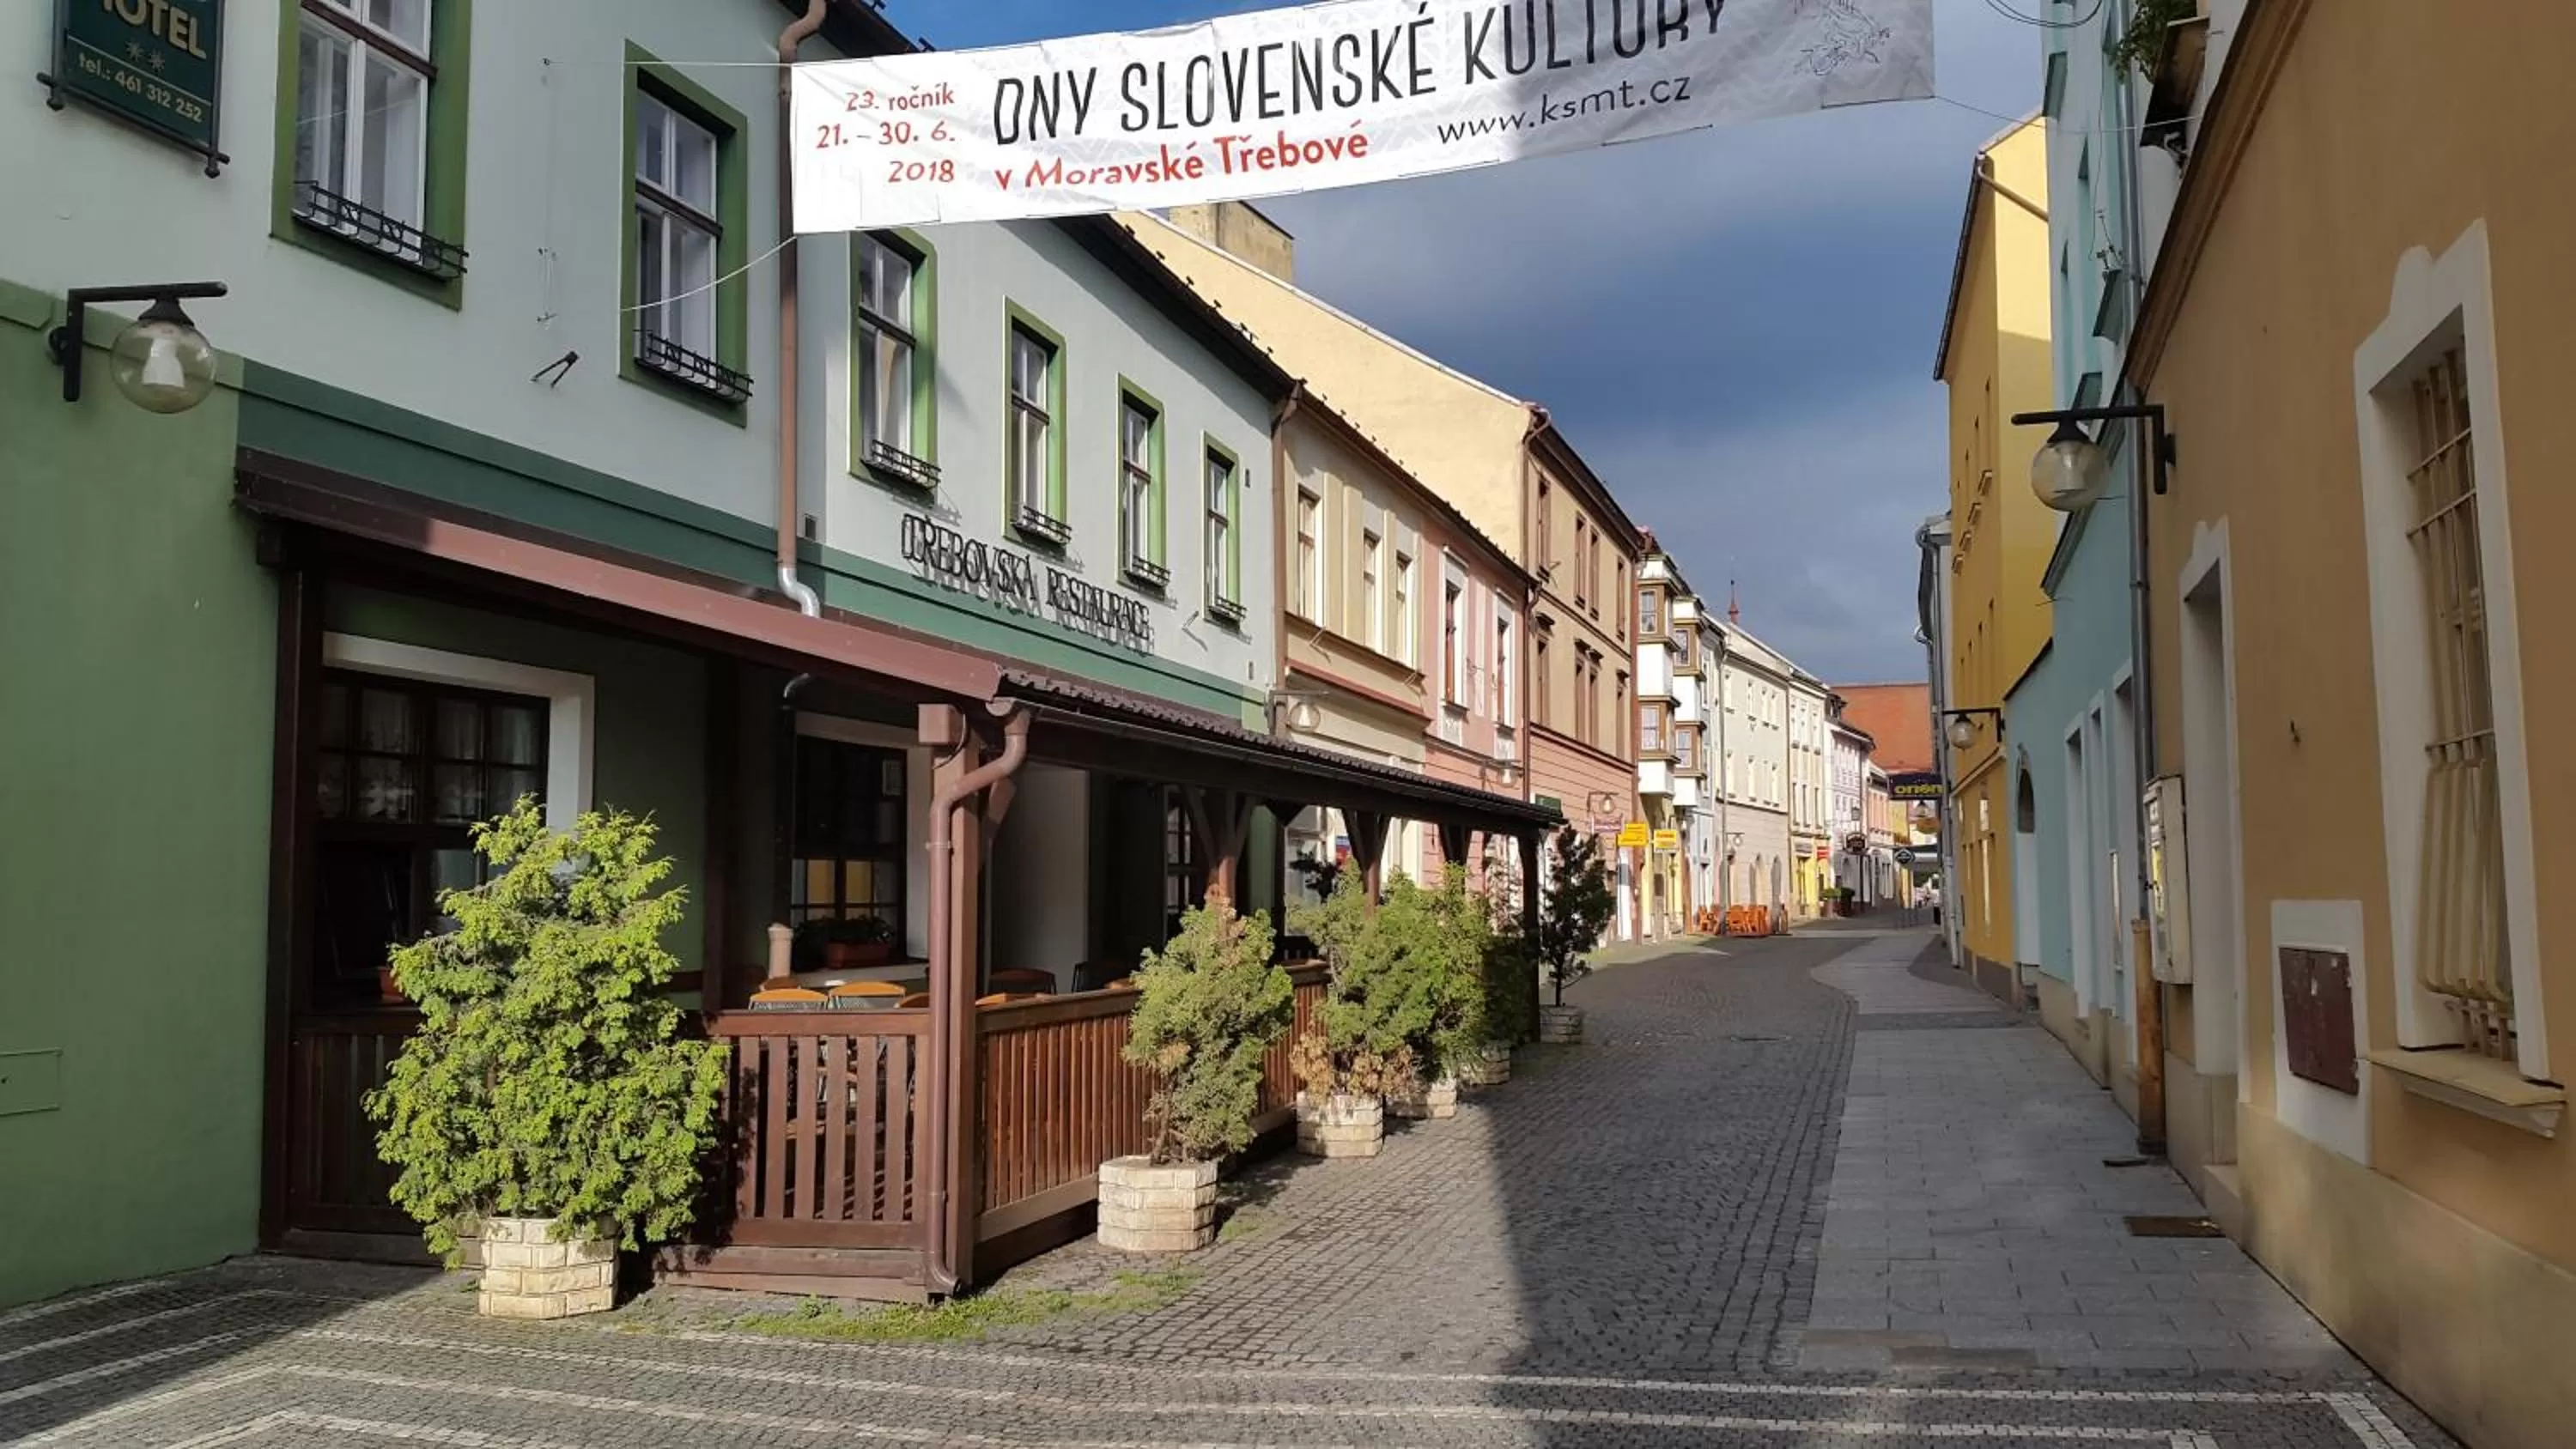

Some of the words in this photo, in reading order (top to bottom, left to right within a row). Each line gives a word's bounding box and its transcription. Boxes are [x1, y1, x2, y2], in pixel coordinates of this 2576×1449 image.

[102, 0, 207, 59] OTEL
[79, 52, 111, 81] tel.:
[114, 70, 142, 94] 461
[147, 84, 172, 108] 312
[175, 98, 203, 123] 252
[844, 89, 880, 112] 23.
[889, 82, 956, 111] ročník
[993, 67, 1097, 145] DNY
[1121, 1, 1437, 132] SLOVENSKÉ
[930, 120, 956, 142] 6.
[1437, 76, 1691, 145] www.ksmt.cz
[888, 160, 956, 183] 2018
[994, 168, 1013, 191] v
[1024, 141, 1205, 188] Moravské
[1212, 118, 1369, 175] Třebové
